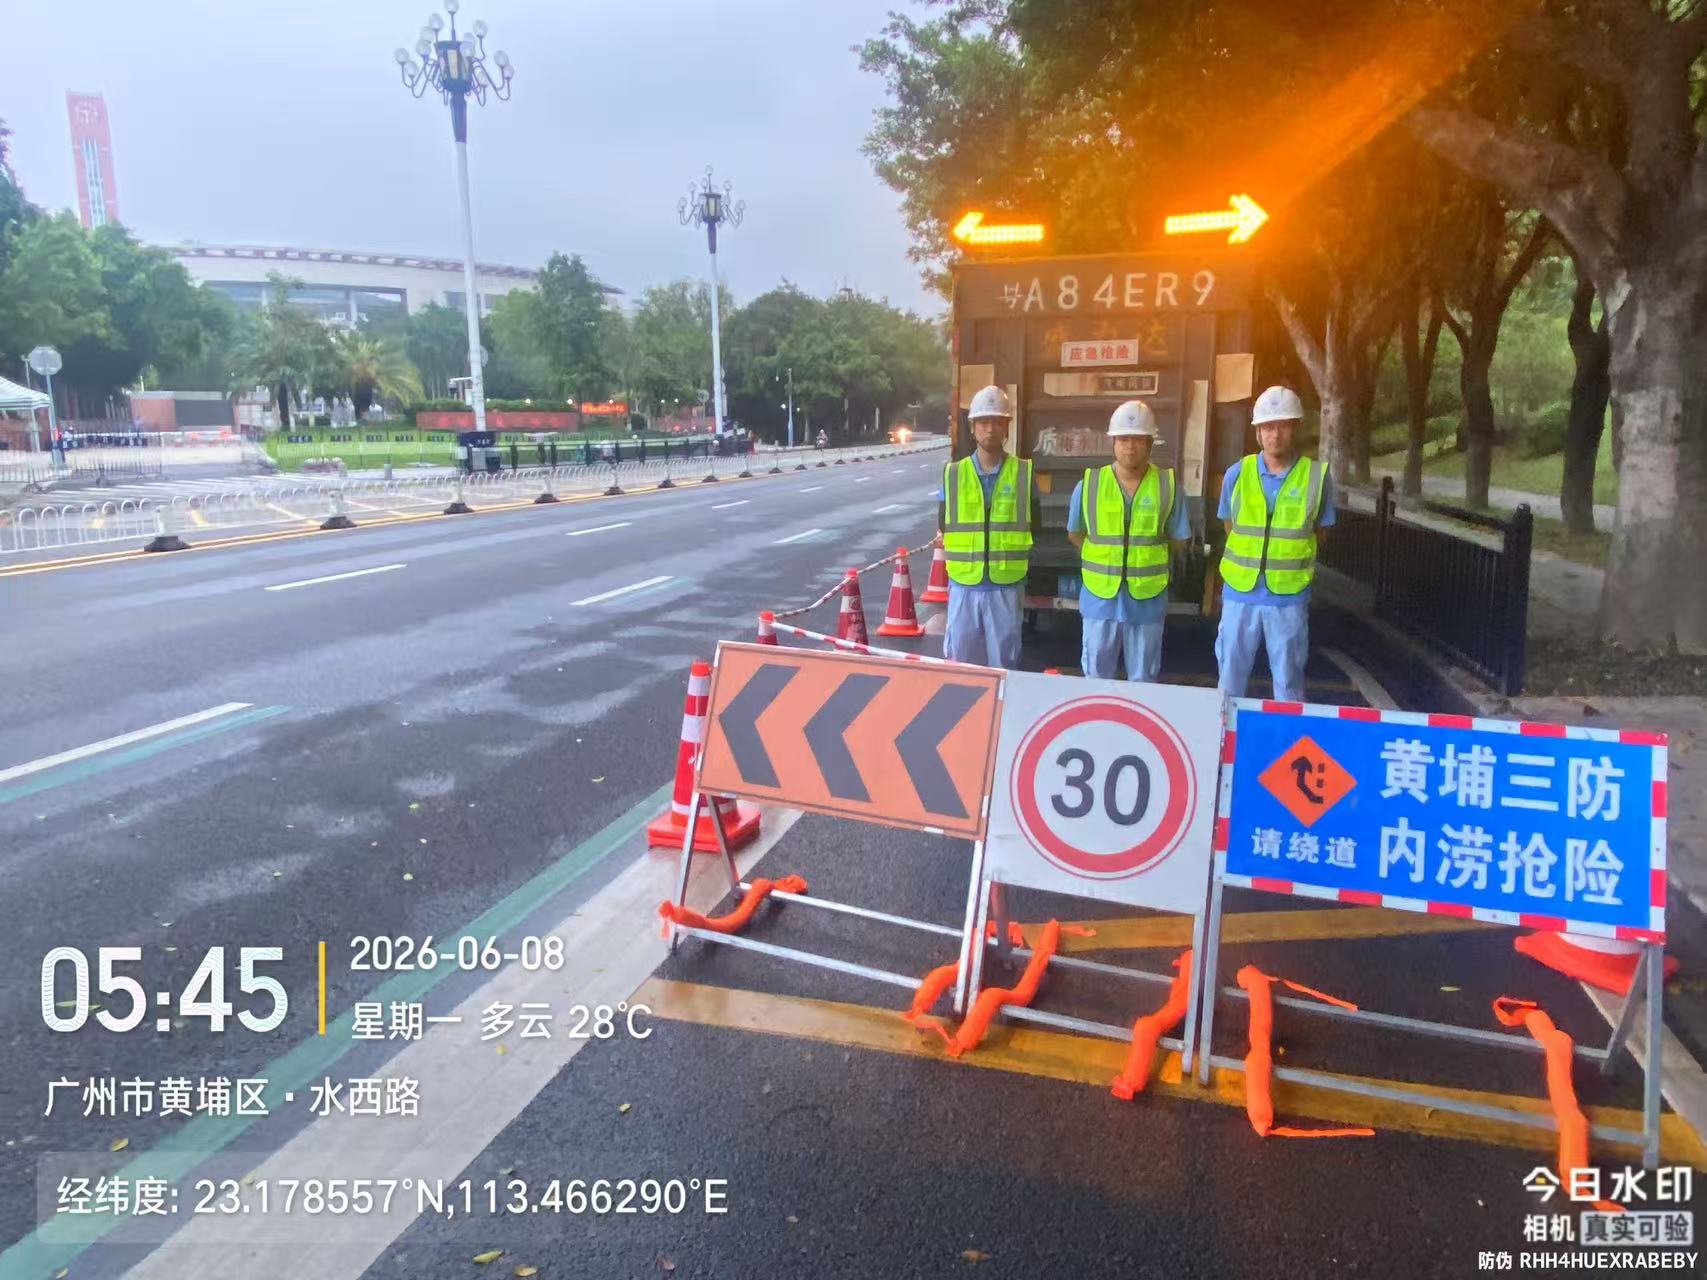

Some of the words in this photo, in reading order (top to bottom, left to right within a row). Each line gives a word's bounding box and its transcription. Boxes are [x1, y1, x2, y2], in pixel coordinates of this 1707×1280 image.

[1051, 748, 1151, 826] 30
[1379, 737, 1626, 822] 黄埔三防
[1251, 826, 1358, 869] 请绕道
[1378, 816, 1625, 906] 内涝抢险
